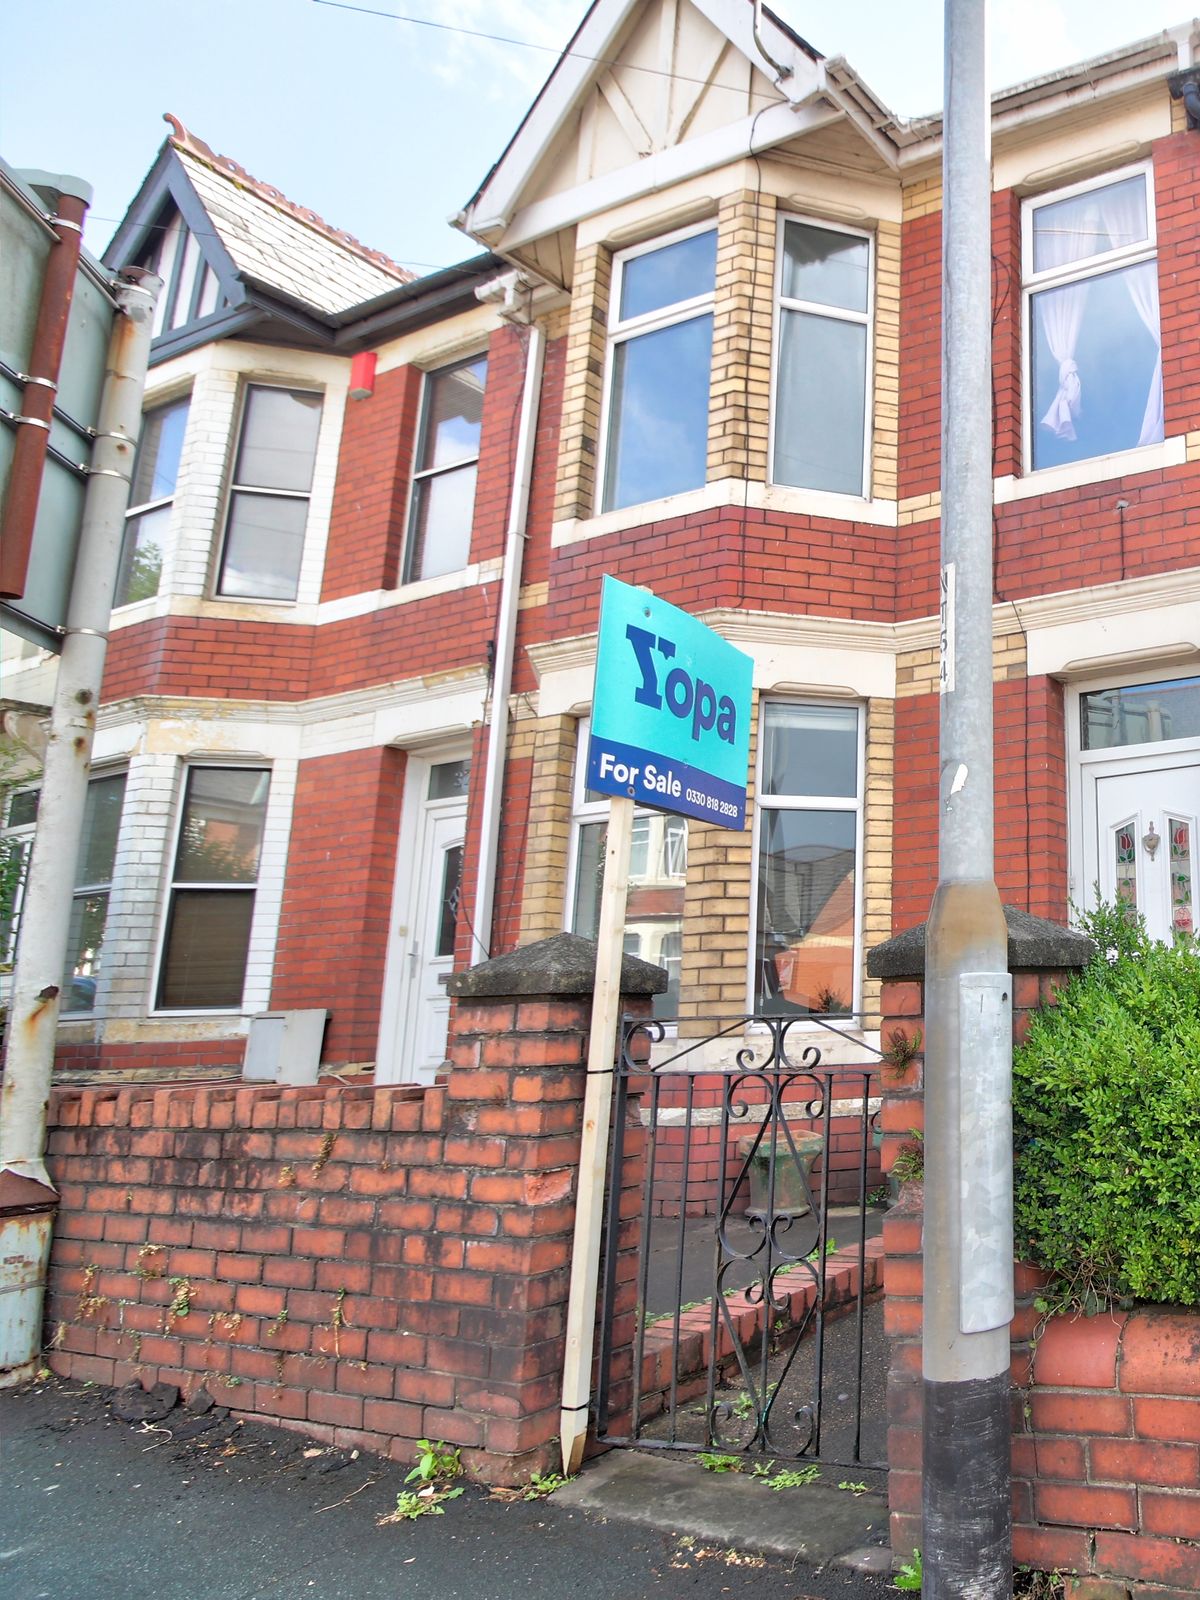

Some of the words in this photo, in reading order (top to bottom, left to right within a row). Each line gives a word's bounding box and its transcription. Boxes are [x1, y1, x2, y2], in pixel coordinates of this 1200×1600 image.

[626, 624, 736, 745] Yopa
[600, 753, 639, 785] For
[643, 764, 682, 798] Sale
[686, 788, 706, 806] 0330
[706, 796, 719, 811] 818
[719, 801, 738, 817] 2828
